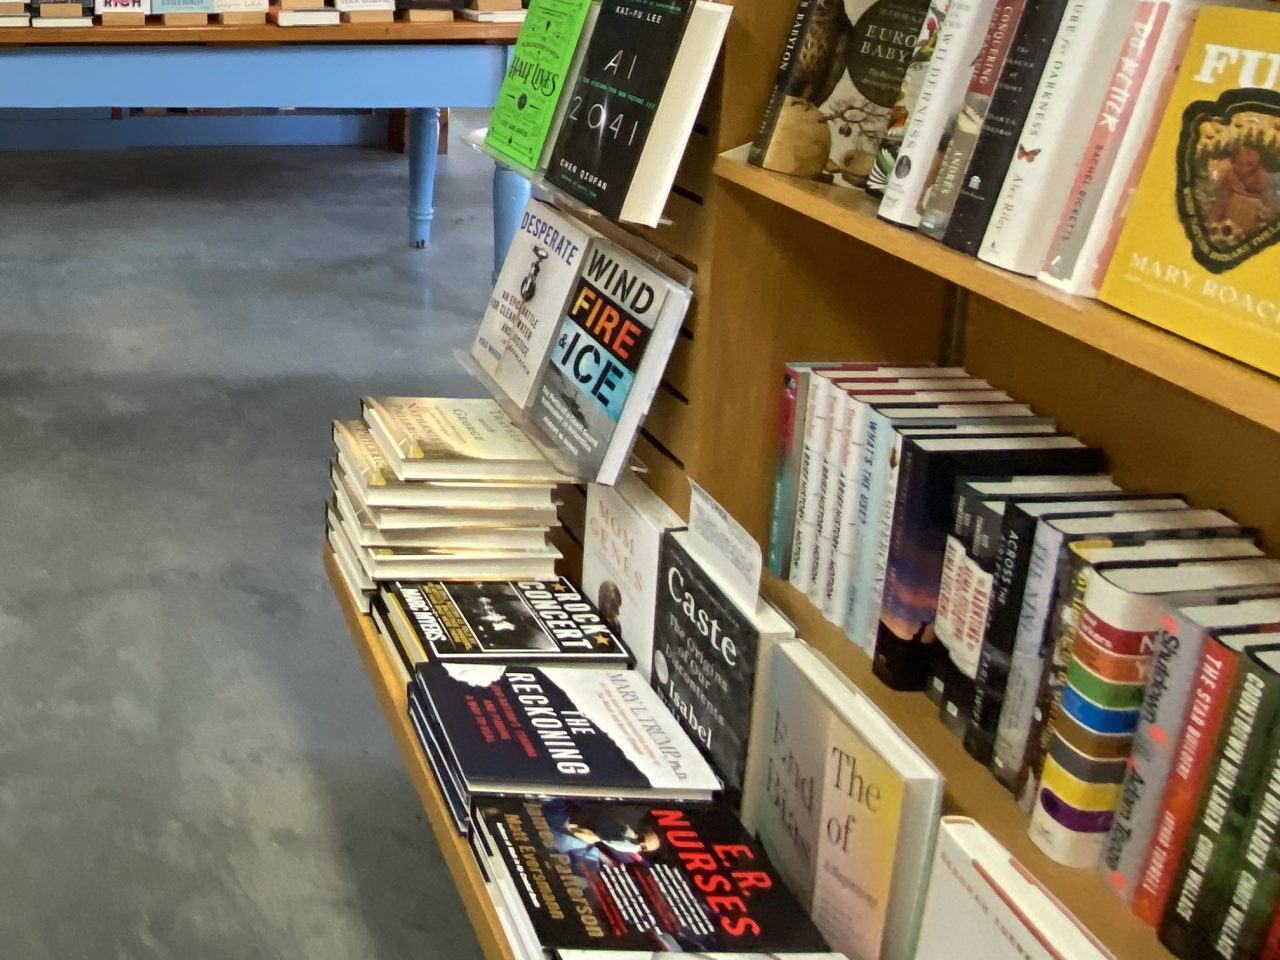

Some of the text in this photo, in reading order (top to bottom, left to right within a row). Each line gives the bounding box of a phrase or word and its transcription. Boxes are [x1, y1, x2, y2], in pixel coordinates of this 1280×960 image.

[616, 6, 663, 24] KAI-FU LEE
[779, 12, 805, 71] BABYLON
[978, 6, 1014, 85] CONQUERING
[569, 96, 639, 146] 2041
[906, 32, 954, 150] WILDERNESS
[1029, 61, 1064, 138] DARKNESS
[520, 211, 579, 266] DESPERATE
[587, 248, 655, 314] WIND
[571, 286, 642, 360] FIRE
[561, 332, 624, 407] ICE
[858, 420, 877, 524] WHAT'S THE USE?
[794, 530, 802, 569] MOTION
[811, 545, 820, 584] MOTION
[826, 559, 836, 601] MOTION
[1001, 529, 1019, 579] ACROSS
[518, 581, 593, 649] CONCERT
[554, 592, 611, 638] ROCK
[668, 567, 737, 666] Caste
[1142, 630, 1180, 724] Shutdown
[1199, 654, 1223, 687] THE
[505, 672, 590, 775] RECKONING
[560, 710, 596, 735] THE
[669, 680, 713, 750] Isabel
[1224, 672, 1265, 763] COUNTDOWN
[830, 746, 882, 813] The
[825, 815, 857, 854] of
[649, 809, 761, 938] NURSES
